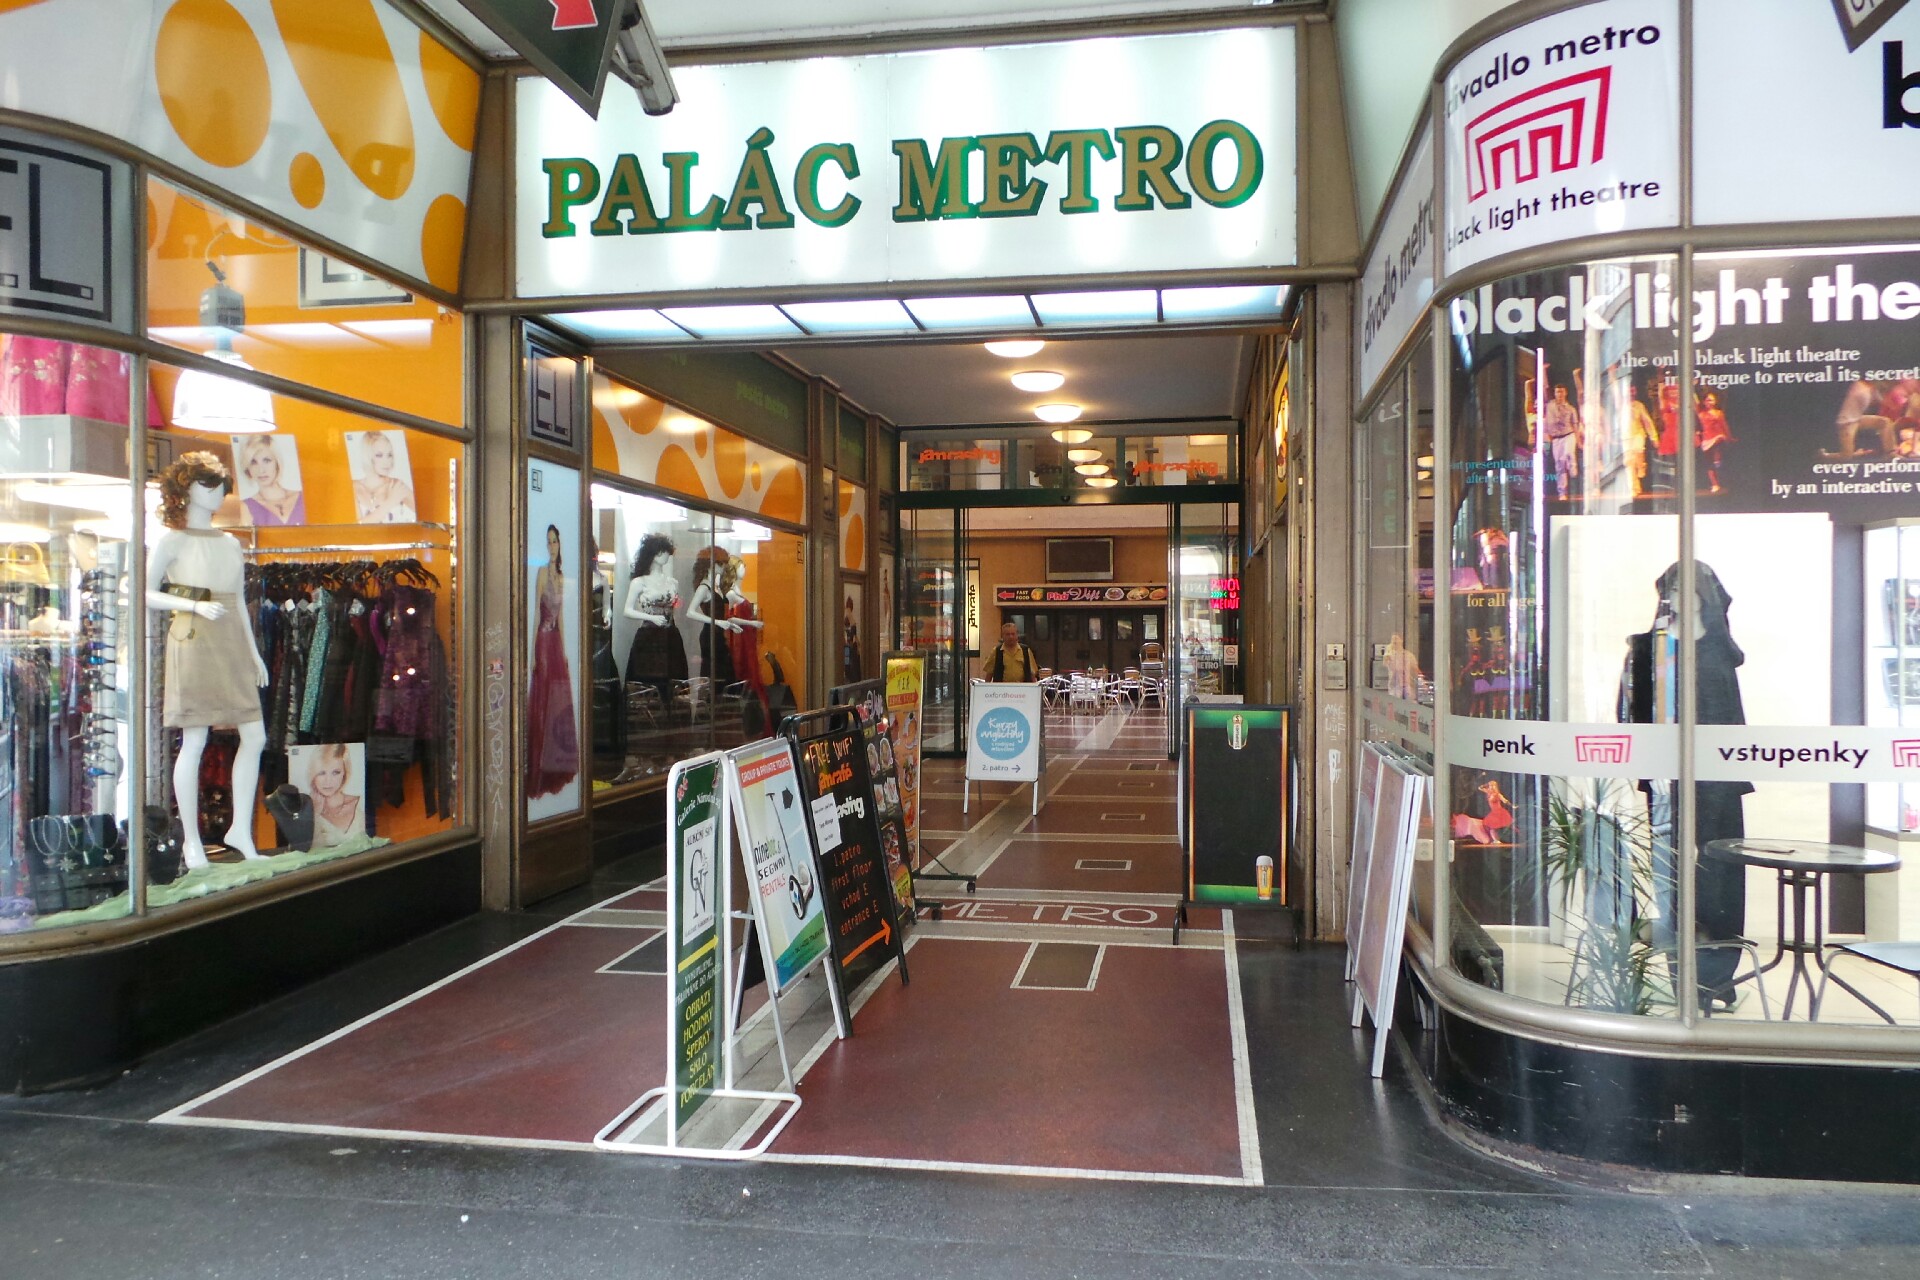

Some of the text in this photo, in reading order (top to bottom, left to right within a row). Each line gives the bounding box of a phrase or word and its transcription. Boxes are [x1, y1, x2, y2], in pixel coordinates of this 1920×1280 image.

[1446, 25, 1660, 118] divadlo metro
[541, 119, 1265, 238] PALÁC METRO
[1489, 197, 1541, 231] light
[1551, 181, 1660, 211] theatre
[1452, 275, 1614, 336] black
[1634, 269, 1789, 342] light
[1620, 346, 1861, 368] the onl black light theatre
[1755, 370, 1773, 385] to
[1777, 366, 1833, 384] reveal
[1838, 366, 1861, 381] its
[1812, 462, 1860, 478] every
[1772, 479, 1792, 498] by
[1796, 483, 1818, 494] an
[1822, 477, 1913, 494] interactive
[1467, 592, 1485, 607] for
[1488, 592, 1506, 607] all
[809, 739, 831, 774] FREE
[1482, 734, 1535, 758] penk
[1718, 740, 1871, 769] vstupenky
[989, 764, 1009, 772] patro
[836, 795, 865, 819] asting
[758, 854, 787, 881] SEGWAY
[852, 860, 873, 879] floor
[760, 873, 786, 897] RENTALS
[685, 987, 712, 1021] OBRAZY
[683, 1006, 714, 1045] HODINKY
[686, 1029, 711, 1063] ŠPERKY
[689, 1051, 708, 1080] SKLO
